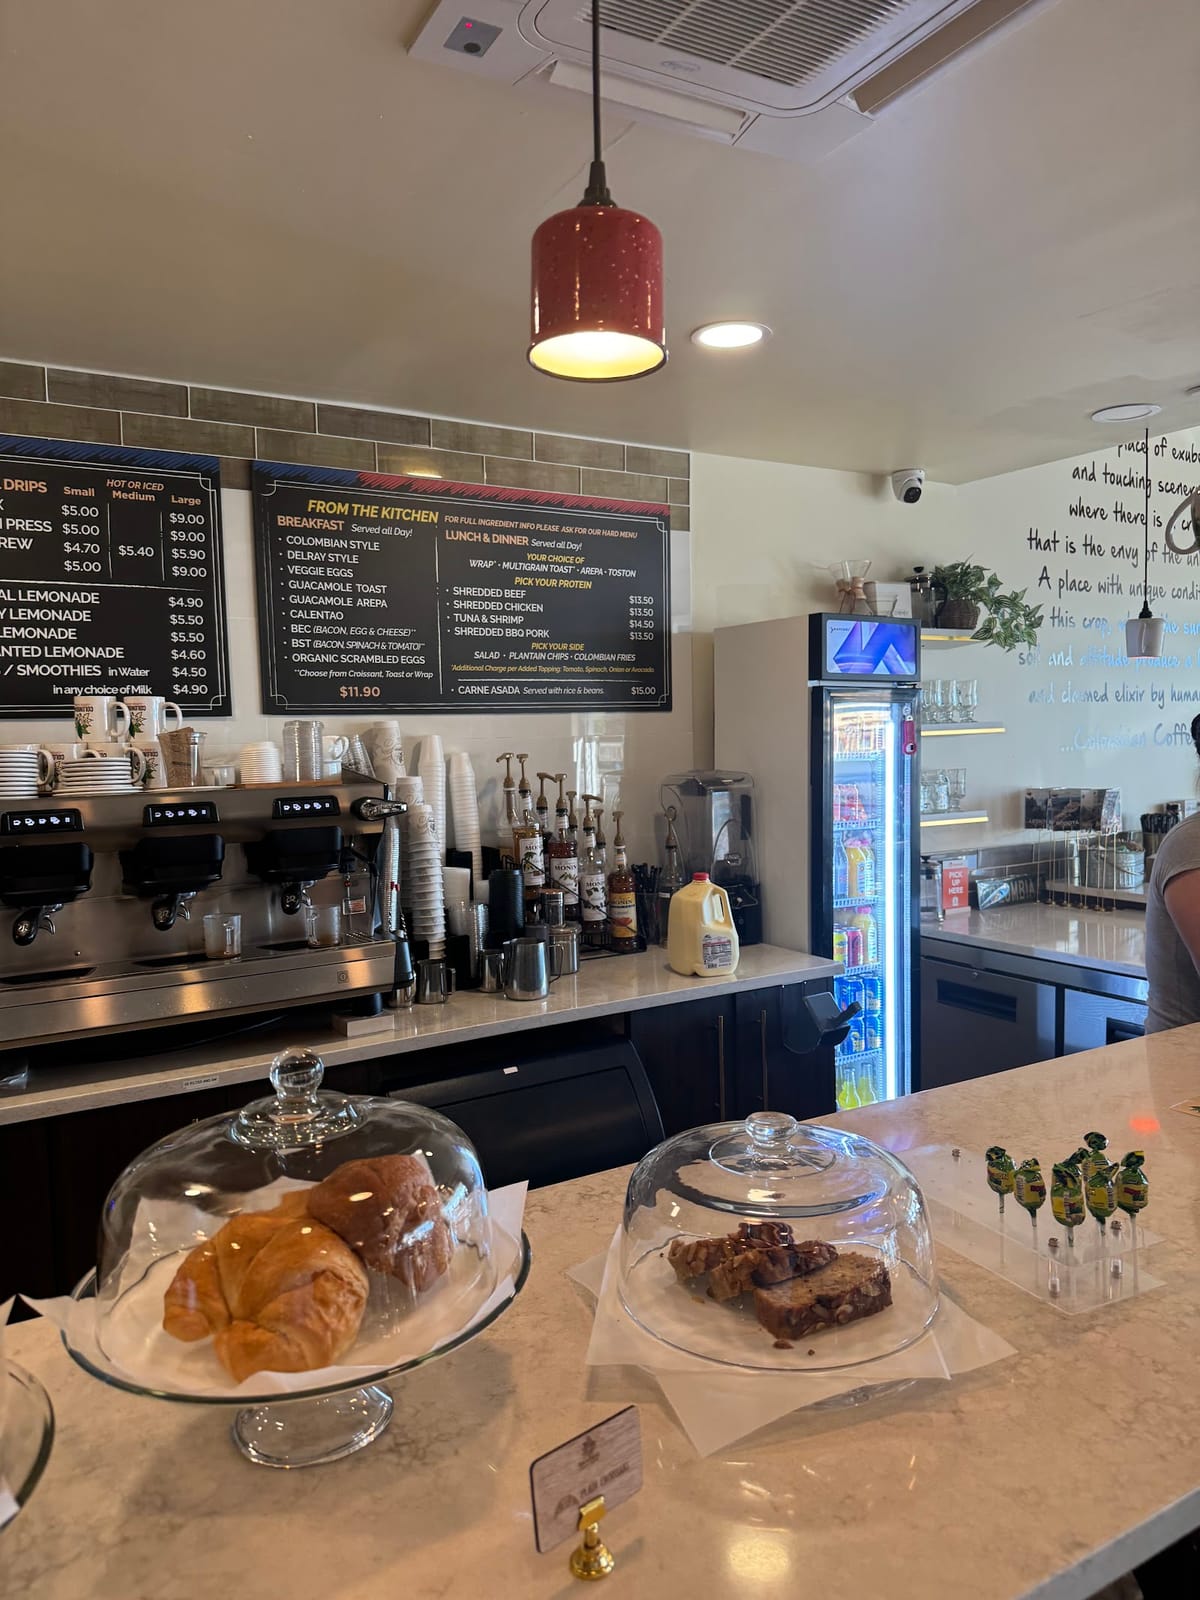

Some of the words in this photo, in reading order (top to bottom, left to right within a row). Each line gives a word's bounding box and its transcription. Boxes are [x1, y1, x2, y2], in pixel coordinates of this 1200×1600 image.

[1154, 437, 1167, 457] of
[4, 479, 47, 493] DRIPS
[106, 479, 126, 489] HOT
[128, 480, 140, 489] OR
[142, 481, 165, 491] ICED
[1073, 466, 1096, 483] and
[1102, 463, 1151, 498] touching
[63, 486, 95, 497] Small
[112, 490, 156, 502] Medium
[171, 495, 201, 506] Large
[62, 505, 98, 517] $5.00
[307, 499, 348, 515] FROM
[352, 503, 378, 518] THE
[381, 507, 438, 523] KITCHEN
[1069, 496, 1107, 522] where
[1113, 501, 1147, 526] there
[1153, 510, 1162, 527] is
[170, 513, 205, 525] $9.00
[7, 520, 53, 532] PRESS
[63, 524, 99, 536] $5.00
[277, 515, 344, 531] BREAKFAST
[352, 524, 380, 534] Served
[381, 526, 392, 535] all
[394, 527, 413, 538] Day!
[460, 517, 477, 525] FULL
[478, 518, 518, 528] INGREDIENT
[519, 522, 535, 530] INFO
[536, 523, 559, 532] PLEASE
[601, 529, 619, 537] HARD
[620, 530, 637, 539] MENU
[171, 531, 205, 542] $9.00
[446, 530, 481, 542] LUNCH
[483, 533, 489, 543] &
[492, 534, 528, 546] DINNER
[531, 539, 555, 548] Served
[557, 541, 565, 549] all
[566, 542, 582, 551] Day!
[63, 542, 100, 554] $4.70
[286, 536, 348, 548] COLOMBIAN
[350, 541, 380, 551] STYLE
[1027, 528, 1060, 552] that
[1065, 535, 1076, 554] is
[1083, 535, 1105, 556] the
[1110, 542, 1139, 568] envy
[1146, 544, 1159, 564] of
[1162, 544, 1182, 564] the
[119, 545, 154, 557] $5.40
[172, 549, 206, 560] $5.90
[288, 551, 326, 562] DELRAY
[328, 553, 359, 564] STYLE
[527, 553, 547, 561] YOUR
[548, 555, 574, 563] CHOICE
[575, 556, 585, 564] OF
[64, 560, 101, 573] $5.00
[172, 566, 207, 578] $9.00
[288, 566, 325, 576] VEGGIE
[327, 567, 353, 577] EGGS
[502, 562, 549, 572] MULTIGRAIN
[580, 567, 603, 576] AREPA
[608, 569, 636, 577] TOSTON
[289, 581, 352, 592] GUACAMOLE
[356, 584, 387, 594] TOAST
[514, 577, 534, 586] PICK
[535, 579, 559, 587] YOUR
[560, 580, 592, 589] PROTEIN
[1038, 566, 1052, 589] A
[1059, 569, 1091, 599] place
[1098, 574, 1123, 595] with
[1130, 580, 1166, 604] unique
[19, 591, 100, 604] LEMONADE
[453, 587, 503, 597] SHREDDED
[505, 590, 526, 598] BEEF
[168, 597, 203, 608] $4.90
[290, 595, 353, 606] GUACAMOLE
[357, 598, 387, 608] AREPA
[453, 600, 503, 611] SHREDDED
[505, 603, 543, 612] CHICKEN
[629, 596, 653, 605] $13.50
[10, 609, 91, 622] LEMONADE
[290, 610, 344, 620] CALENTAO
[629, 608, 653, 617] $13.50
[1050, 606, 1076, 628] this
[170, 614, 203, 626] $5.50
[453, 614, 480, 623] TUNA
[482, 615, 488, 623] &
[490, 615, 524, 625] SHRIMP
[629, 620, 654, 629] $14.50
[291, 624, 311, 633] BEC
[313, 625, 348, 636] (BACON,
[350, 627, 367, 635] EGG
[369, 627, 375, 635] &
[454, 627, 503, 637] SHREDDED
[505, 629, 525, 637] BBQ
[526, 629, 549, 638] PORK
[171, 632, 204, 643] $5.50
[629, 632, 653, 641] $13.50
[292, 639, 311, 648] BST
[313, 640, 345, 650] (BACON,
[346, 640, 380, 649] SPINACH
[381, 641, 386, 649] &
[532, 642, 548, 650] PICK
[45, 647, 124, 659] LEMONADE
[171, 649, 206, 661] $4.60
[292, 653, 338, 663] ORGANIC
[341, 654, 399, 664] SCRAMBLED
[401, 655, 425, 665] EGGS
[474, 651, 500, 659] SALAD
[509, 652, 546, 660] PLANTAIN
[547, 652, 569, 660] CHIPS
[574, 653, 616, 662] COLOMBIAN
[617, 653, 636, 662] FRIES
[1048, 646, 1073, 666] and
[17, 665, 101, 676] SMOOTHIES
[109, 667, 118, 676] in
[118, 667, 150, 676] Water
[172, 667, 207, 678] $4.50
[329, 670, 346, 679] from
[348, 669, 383, 678] Croissant,
[385, 670, 405, 678] Toast
[415, 670, 433, 680] Wrap
[485, 664, 506, 673] Charge
[518, 665, 537, 673] Added
[53, 685, 63, 694] in
[64, 687, 84, 696] any
[84, 685, 118, 694] choice
[119, 685, 130, 694] of
[131, 685, 152, 694] Milk
[173, 684, 207, 695] $4.90
[340, 686, 381, 698] $11.90
[458, 686, 489, 695] CARNE
[491, 686, 520, 695] ASADA
[523, 687, 548, 695] Served
[631, 687, 656, 696] $15.00
[1115, 683, 1145, 703] elixir
[1152, 684, 1164, 710] by
